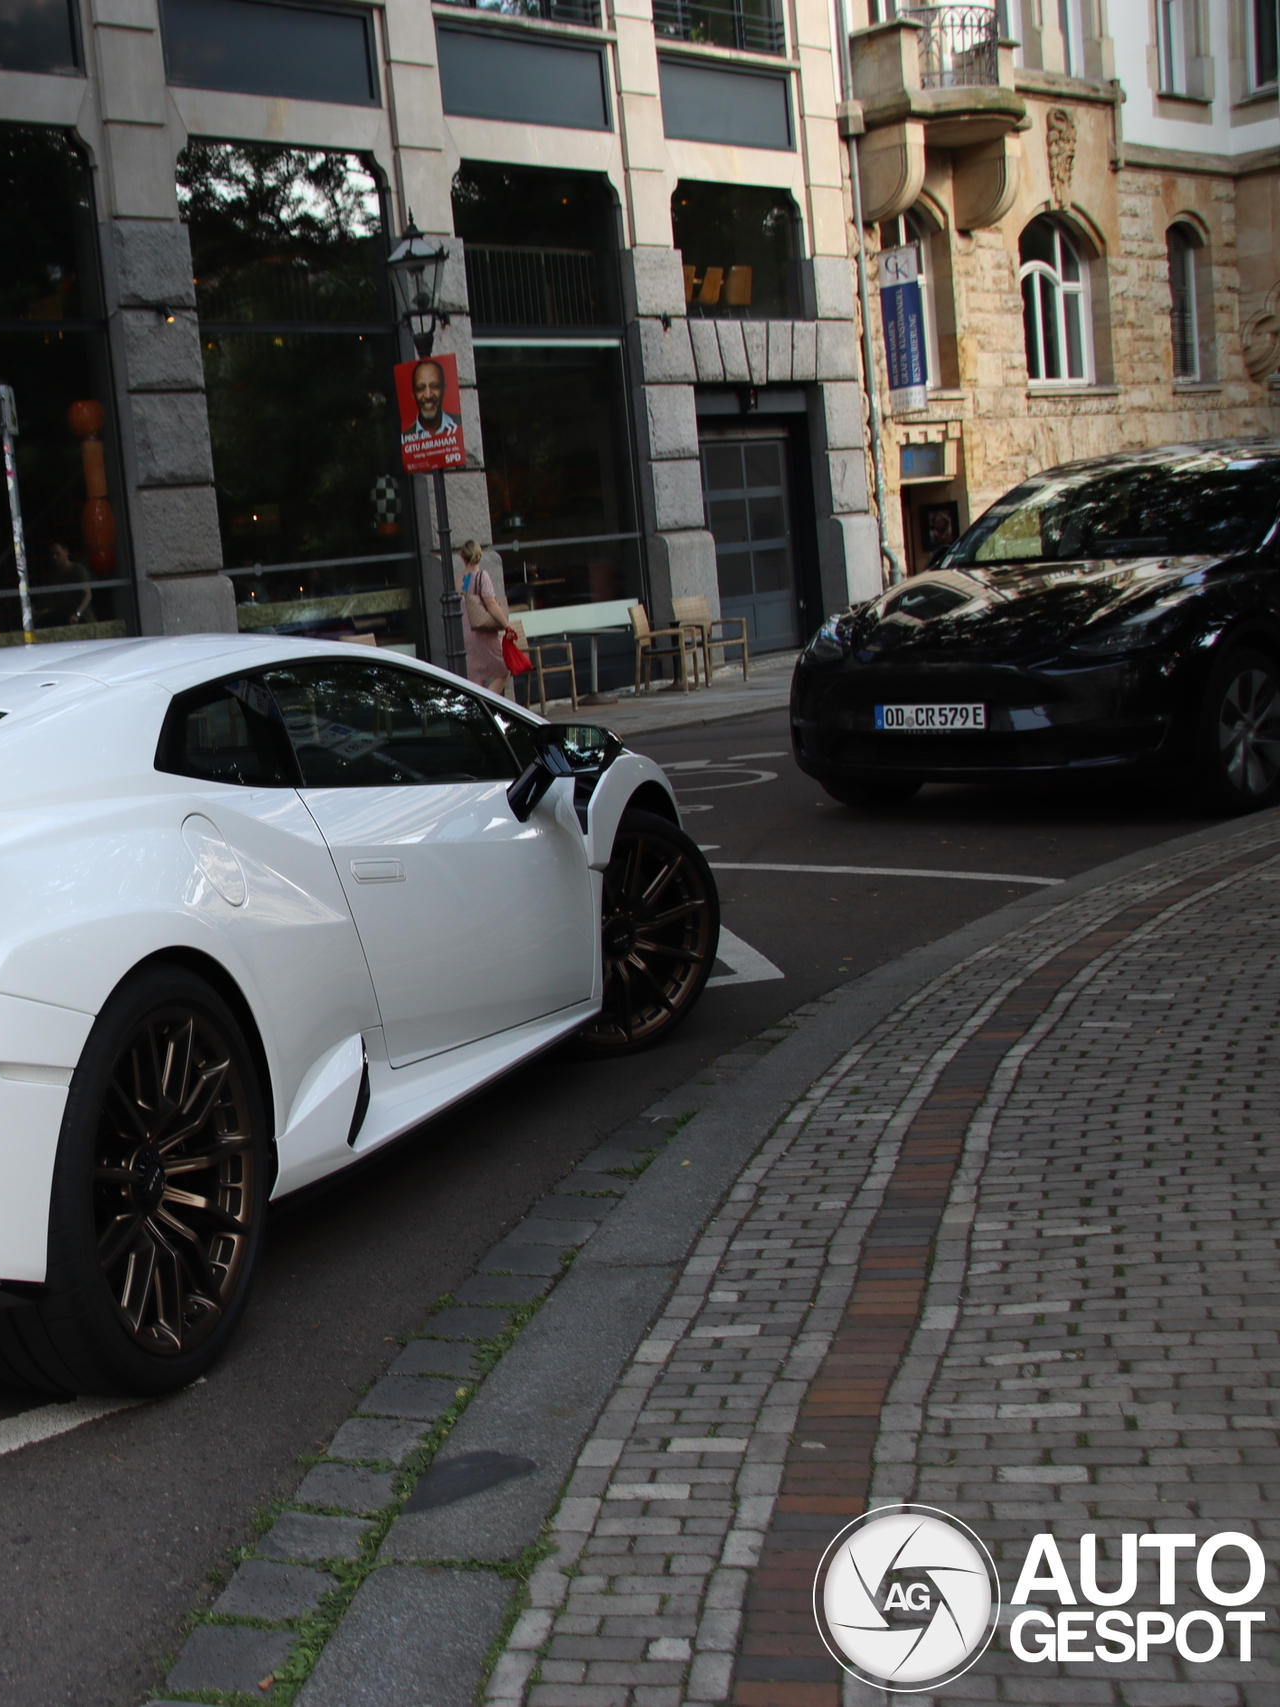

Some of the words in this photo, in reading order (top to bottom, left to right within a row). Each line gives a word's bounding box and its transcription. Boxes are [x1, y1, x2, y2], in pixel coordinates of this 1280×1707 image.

[895, 287, 907, 351] KUNSTHANDEL
[908, 313, 921, 384] RESTAURIERUNG
[404, 441, 420, 454] GETU
[421, 436, 457, 450] ABRAHAM
[445, 453, 461, 464] SPD
[914, 707, 935, 727] CR
